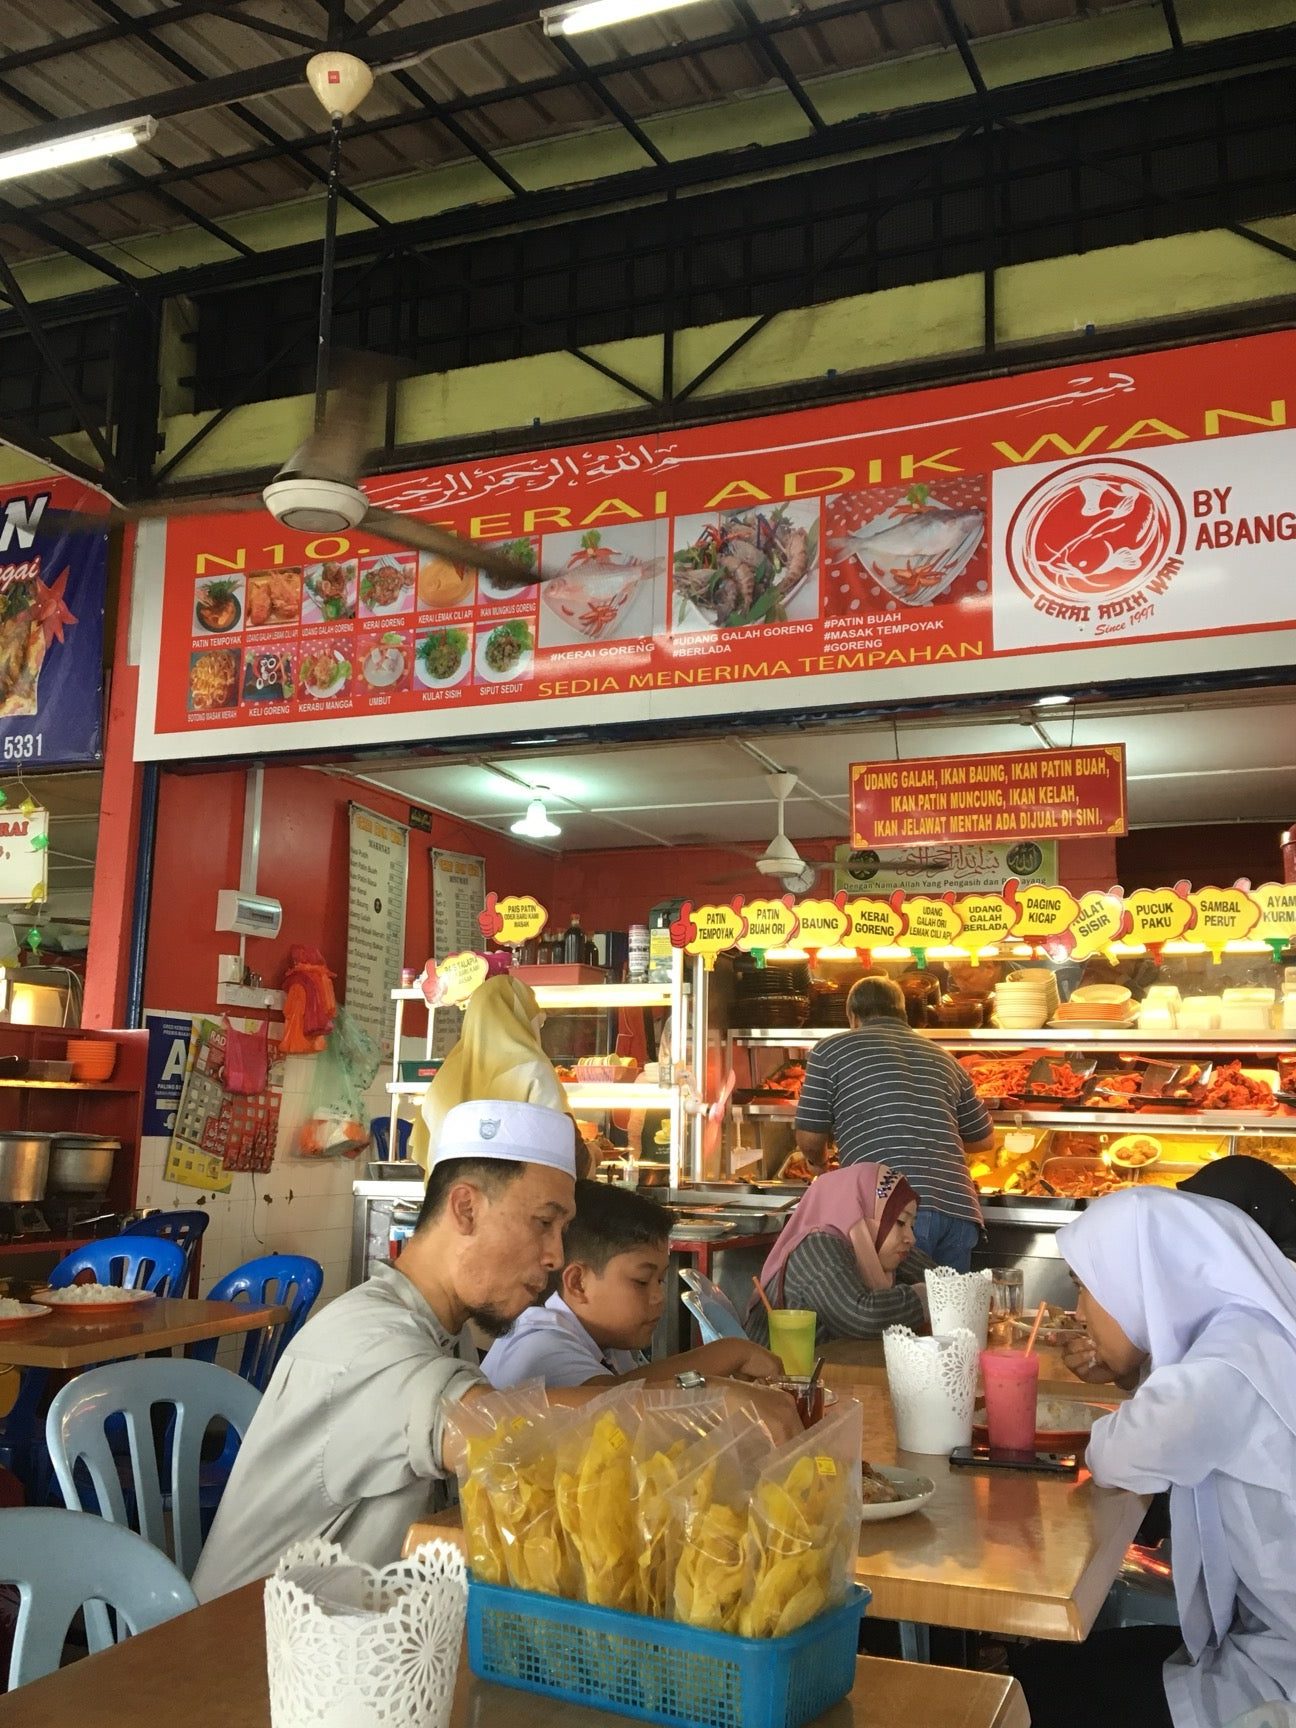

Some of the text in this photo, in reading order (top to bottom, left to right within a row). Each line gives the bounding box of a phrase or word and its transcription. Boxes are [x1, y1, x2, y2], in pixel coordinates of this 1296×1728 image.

[196, 537, 370, 574] N10.
[704, 448, 965, 508] ADIK
[991, 400, 1285, 464] WAN
[1194, 486, 1232, 517] BY
[1195, 512, 1296, 551] ABANG
[0, 557, 40, 592] gai
[1145, 556, 1184, 596] WAN
[823, 612, 901, 629] #PATIN BUAH
[1094, 604, 1155, 636] Since 1997
[672, 624, 814, 647] #UDANG GALAH GORENG
[823, 620, 944, 640] #MASAK TEMPOYAK
[192, 635, 242, 648] PATIN TEMPOYAK
[823, 639, 883, 652] #GORENG
[550, 643, 655, 662] #KERAI GORENG
[672, 644, 732, 658] #BERLADA
[538, 641, 983, 697] SEDIA MENERIMA TEMPAHAN
[480, 683, 523, 696] SIPUT SEDUT
[368, 696, 392, 706] UMBUT
[422, 692, 444, 701] KULAT
[249, 705, 290, 717] KELI GORENG
[299, 700, 353, 713] KERABU MANGGA
[4, 734, 43, 760] 5331
[864, 757, 1110, 791] UDANG GALAH, IKAN BAUNG, IKAN PATIN BUAH,
[891, 785, 1080, 813] IKAN PATIN MUNCUNG, IKAN KELAH,
[874, 820, 898, 837] IKAN
[901, 816, 946, 836] JELAWAT
[950, 813, 993, 833] MENTAH
[995, 811, 1017, 830] ADA
[1020, 809, 1058, 828] DIJUAL
[1062, 808, 1073, 827] DI
[874, 880, 900, 889] Nama
[900, 878, 921, 888] Allah
[922, 878, 942, 890] Yang
[943, 876, 982, 889] Pengasih
[983, 877, 999, 886] dan
[968, 904, 1002, 914] UDANG
[1026, 898, 1061, 910] DAGING
[1136, 902, 1174, 916] PUCUK
[1200, 900, 1241, 913] SAMBAL
[756, 908, 780, 920] PATIN
[860, 910, 889, 924] KERAI
[922, 906, 944, 916] UDANG
[706, 912, 726, 925] PATIN
[802, 918, 838, 930] BAUNG
[916, 916, 948, 928] GALAH ORI
[970, 914, 1002, 922] GALAH
[1028, 912, 1057, 924] KICAP
[1141, 917, 1172, 930] PAKU
[1204, 916, 1237, 928] PERUT
[750, 923, 786, 935] BUAH ORI
[854, 924, 894, 937] GORENG
[910, 926, 930, 938] LEMAK
[963, 922, 1008, 932] BERLADA
[1078, 914, 1111, 937] SISIR
[699, 928, 734, 940] TEMPOYAK
